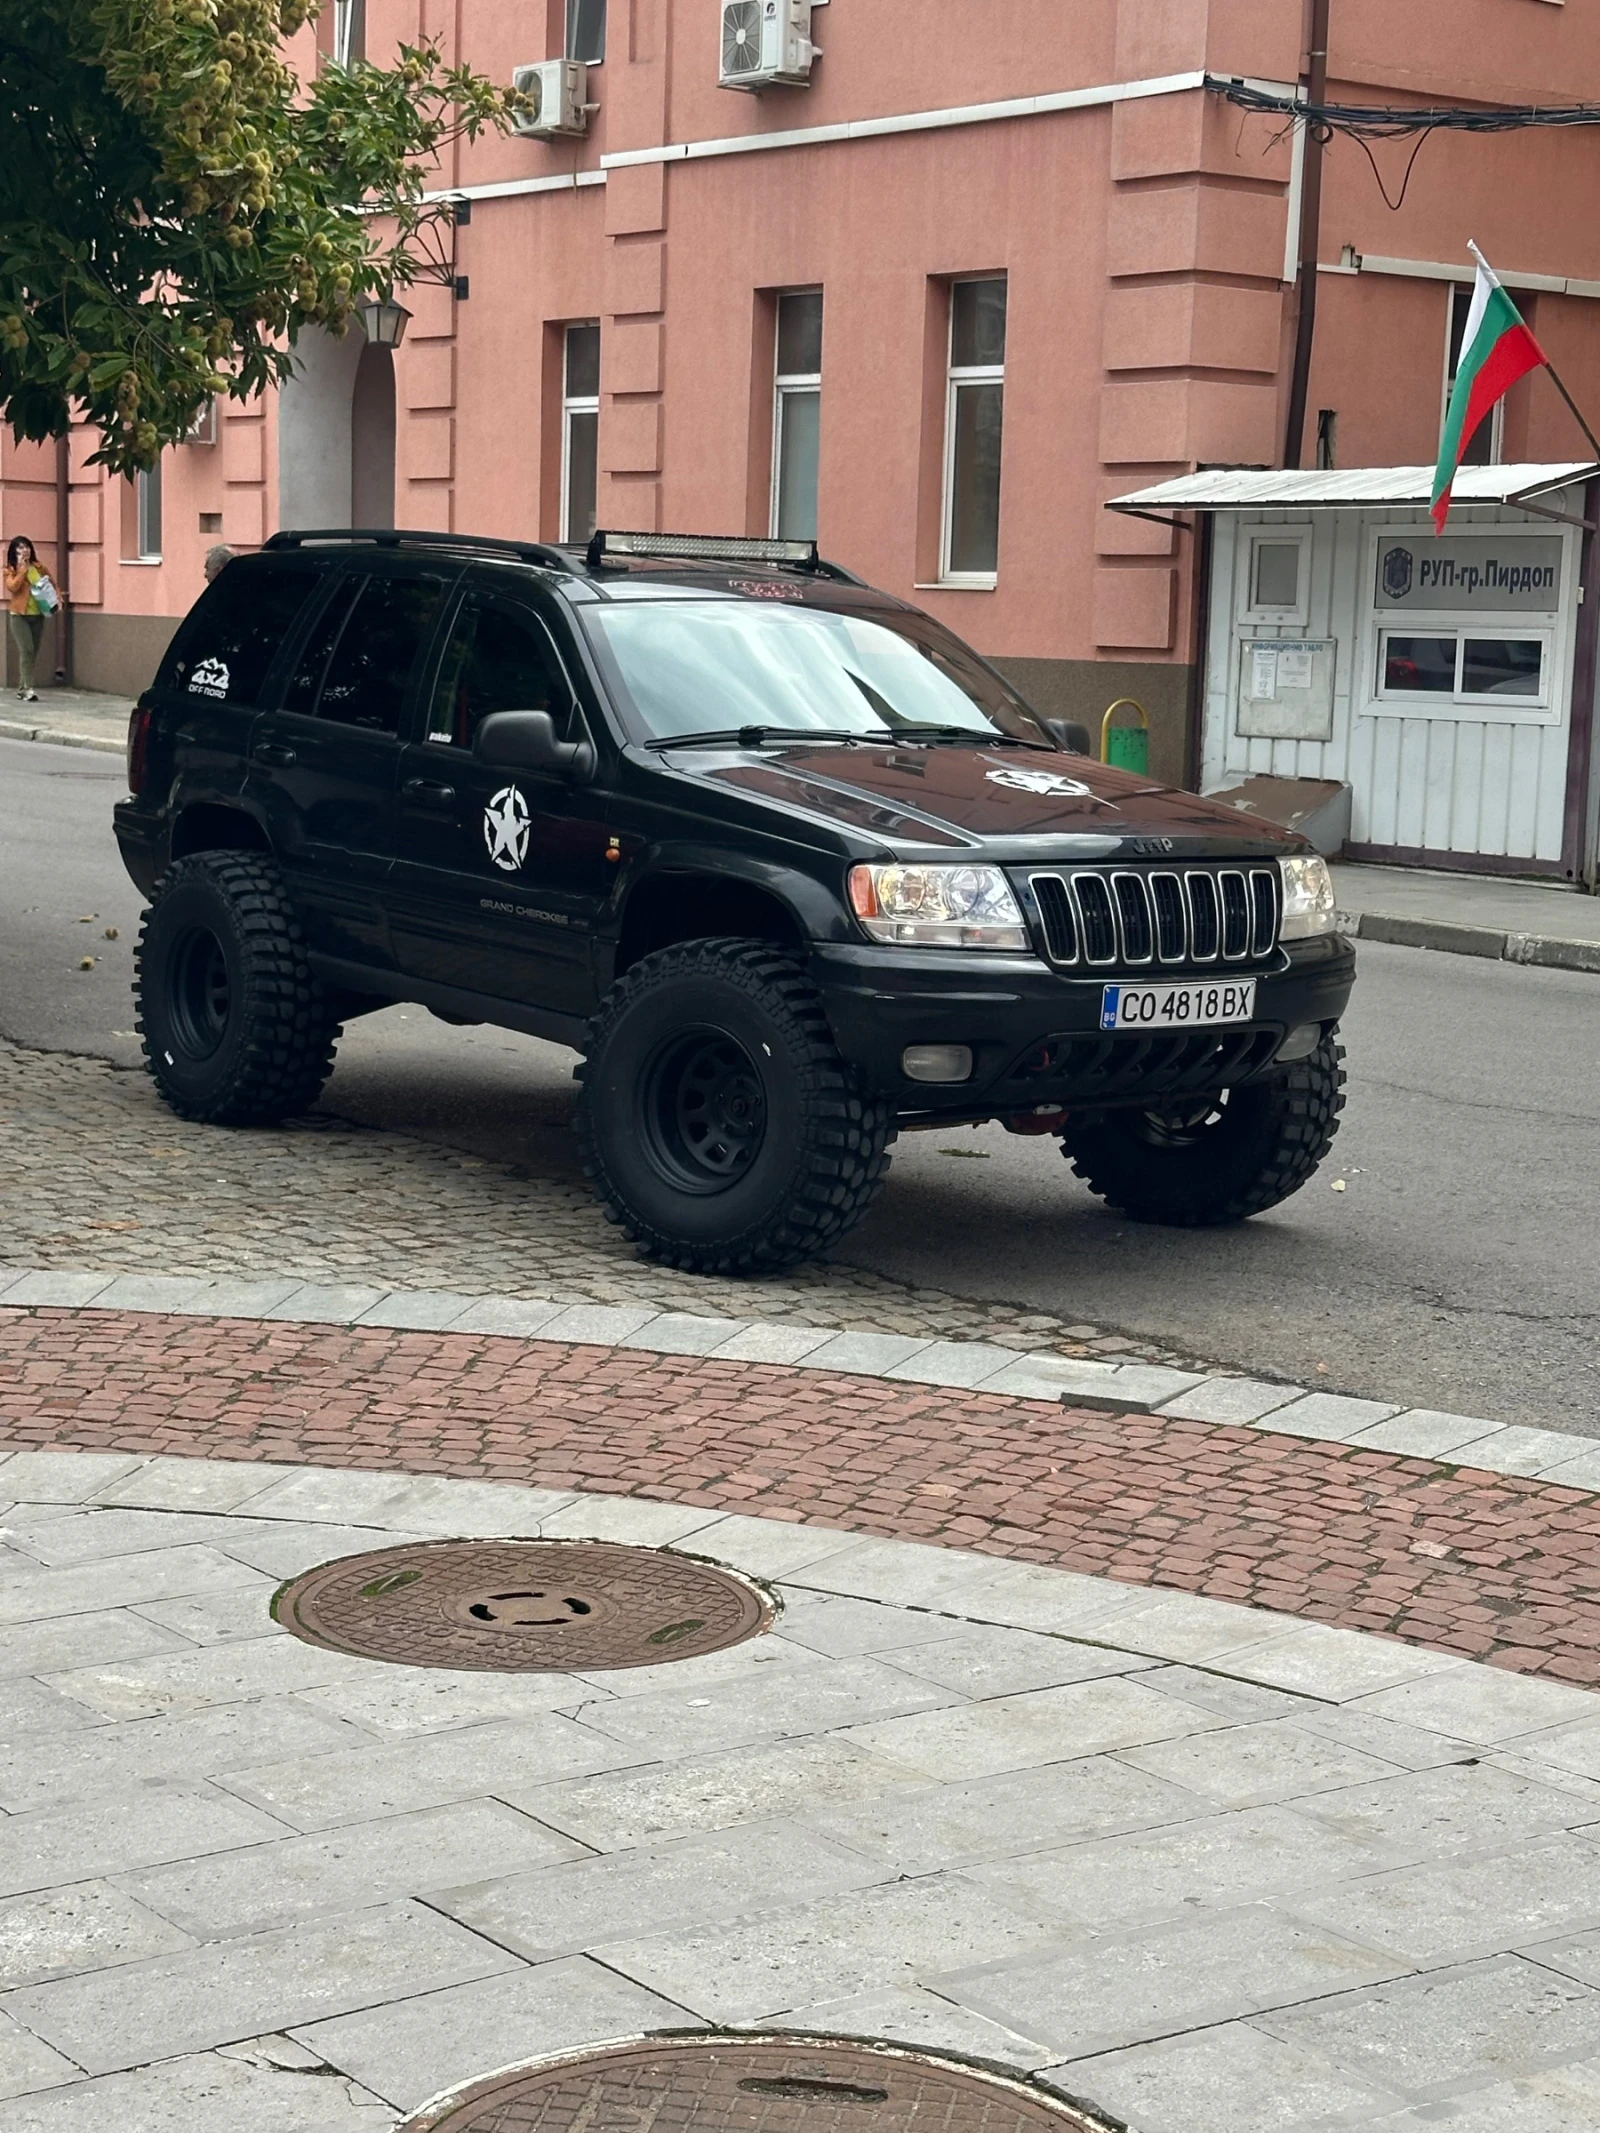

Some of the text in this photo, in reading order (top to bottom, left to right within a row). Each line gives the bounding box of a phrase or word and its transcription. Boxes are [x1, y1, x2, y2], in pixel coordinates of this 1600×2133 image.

[1420, 560, 1554, 594] РУП-гр.Пирдоп
[480, 899, 514, 913] GRAND
[515, 906, 569, 925] CHEROKEE
[1104, 1012, 1115, 1021] BG
